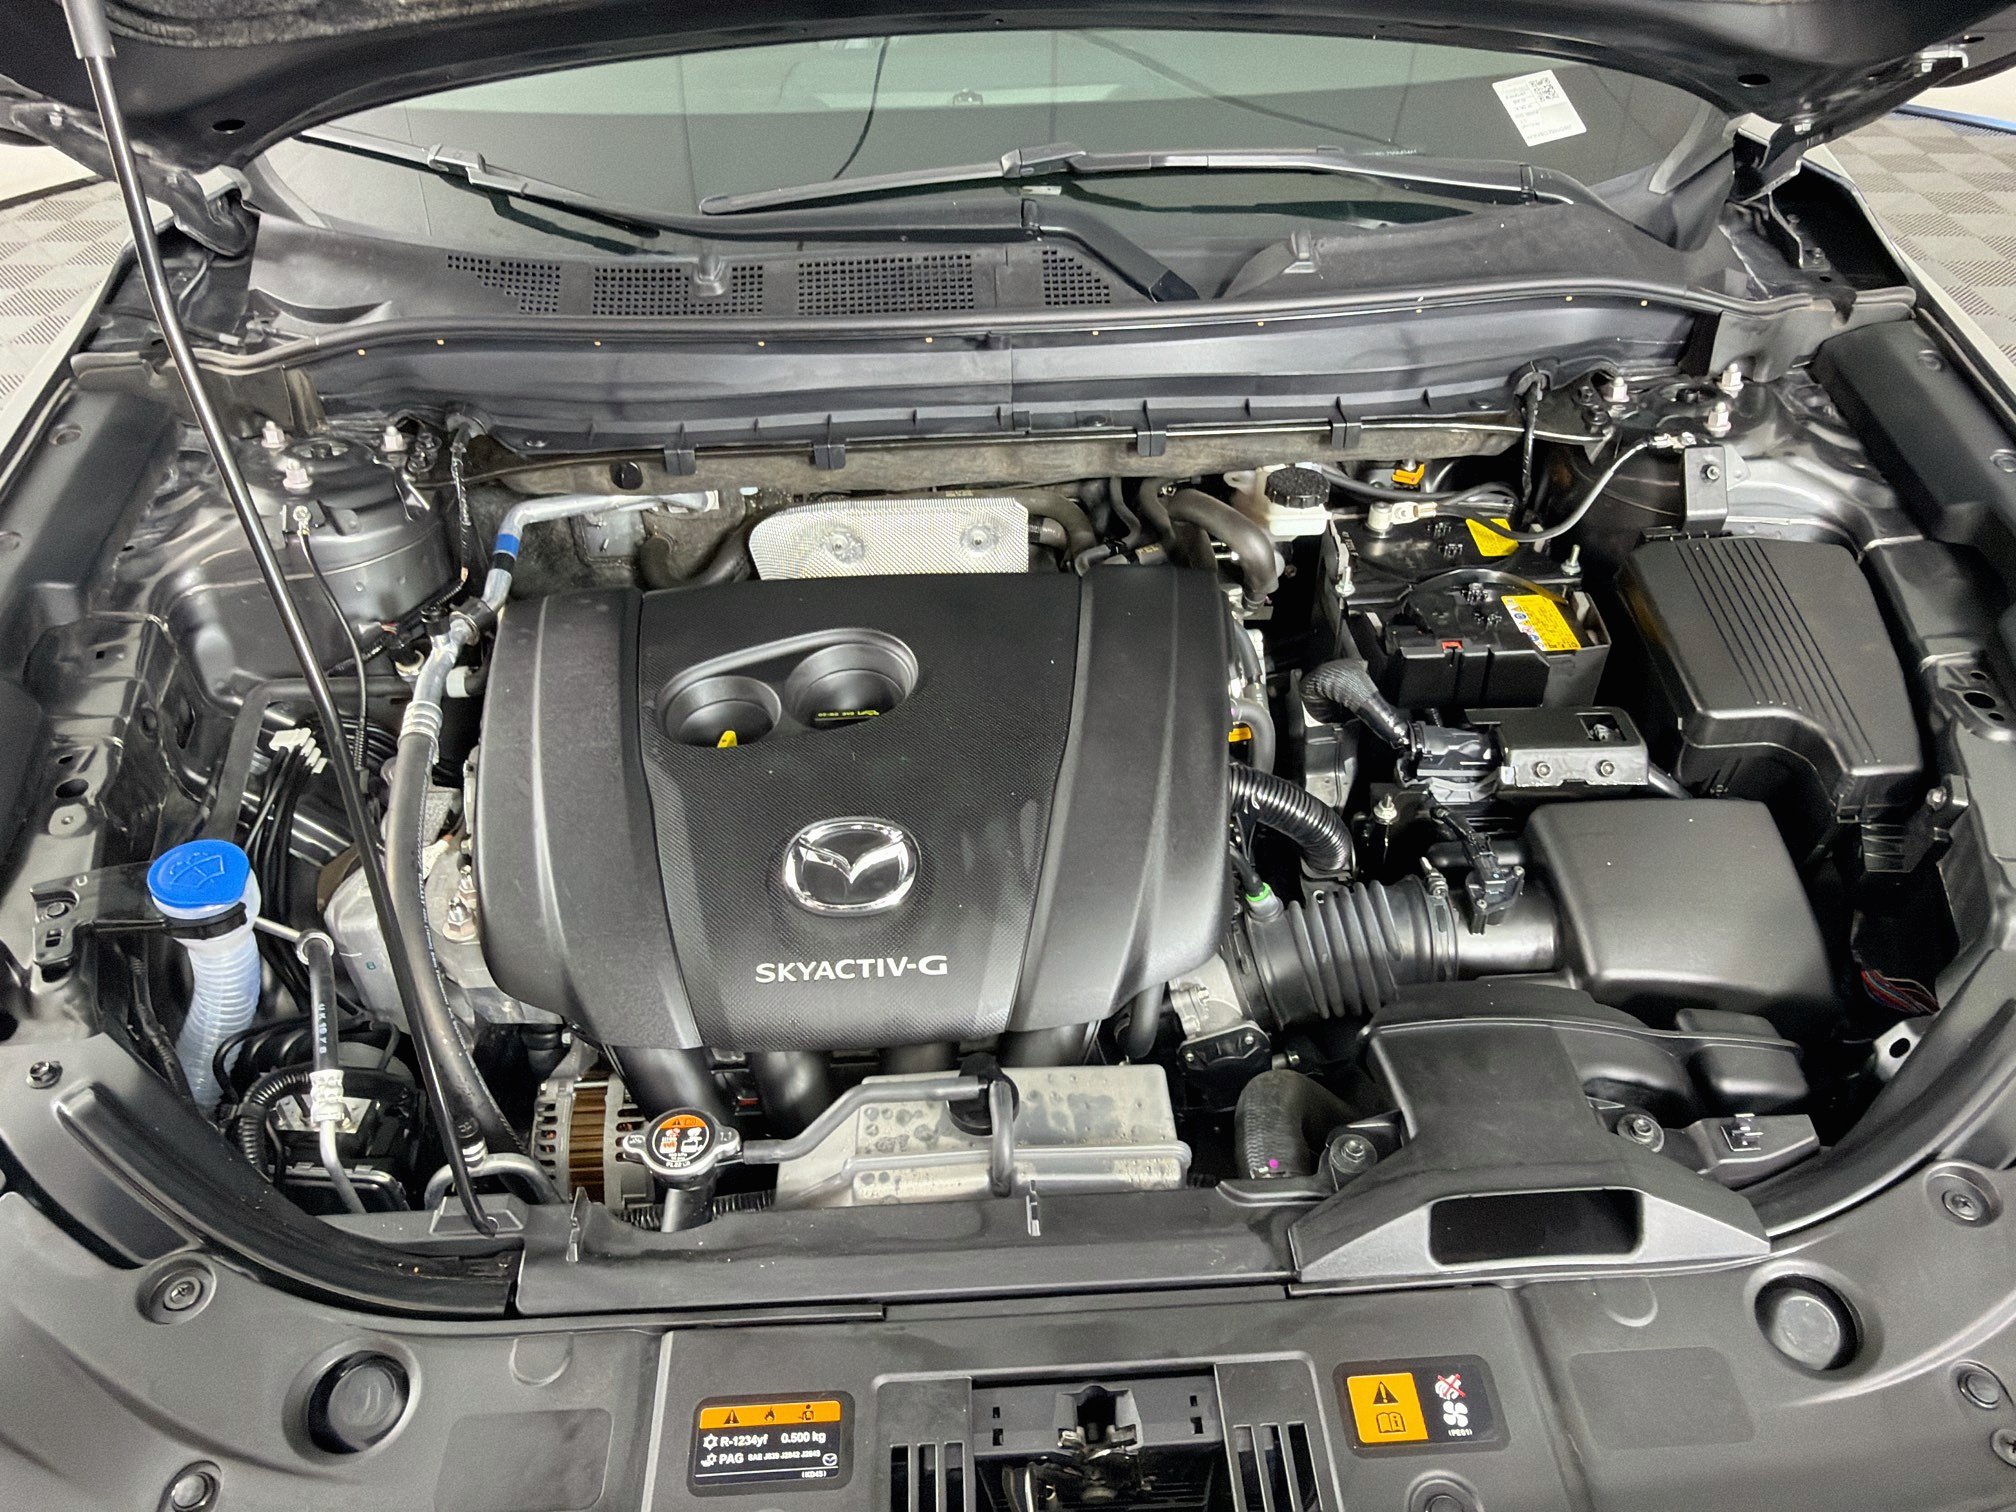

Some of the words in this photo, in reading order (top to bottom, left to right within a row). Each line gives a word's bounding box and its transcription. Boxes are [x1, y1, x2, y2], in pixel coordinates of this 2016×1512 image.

[755, 955, 948, 983] SKYACTIV-G
[719, 1434, 769, 1448] R-1234yf
[780, 1431, 810, 1443] 0.500
[811, 1431, 827, 1444] kg
[718, 1453, 744, 1465] PAG
